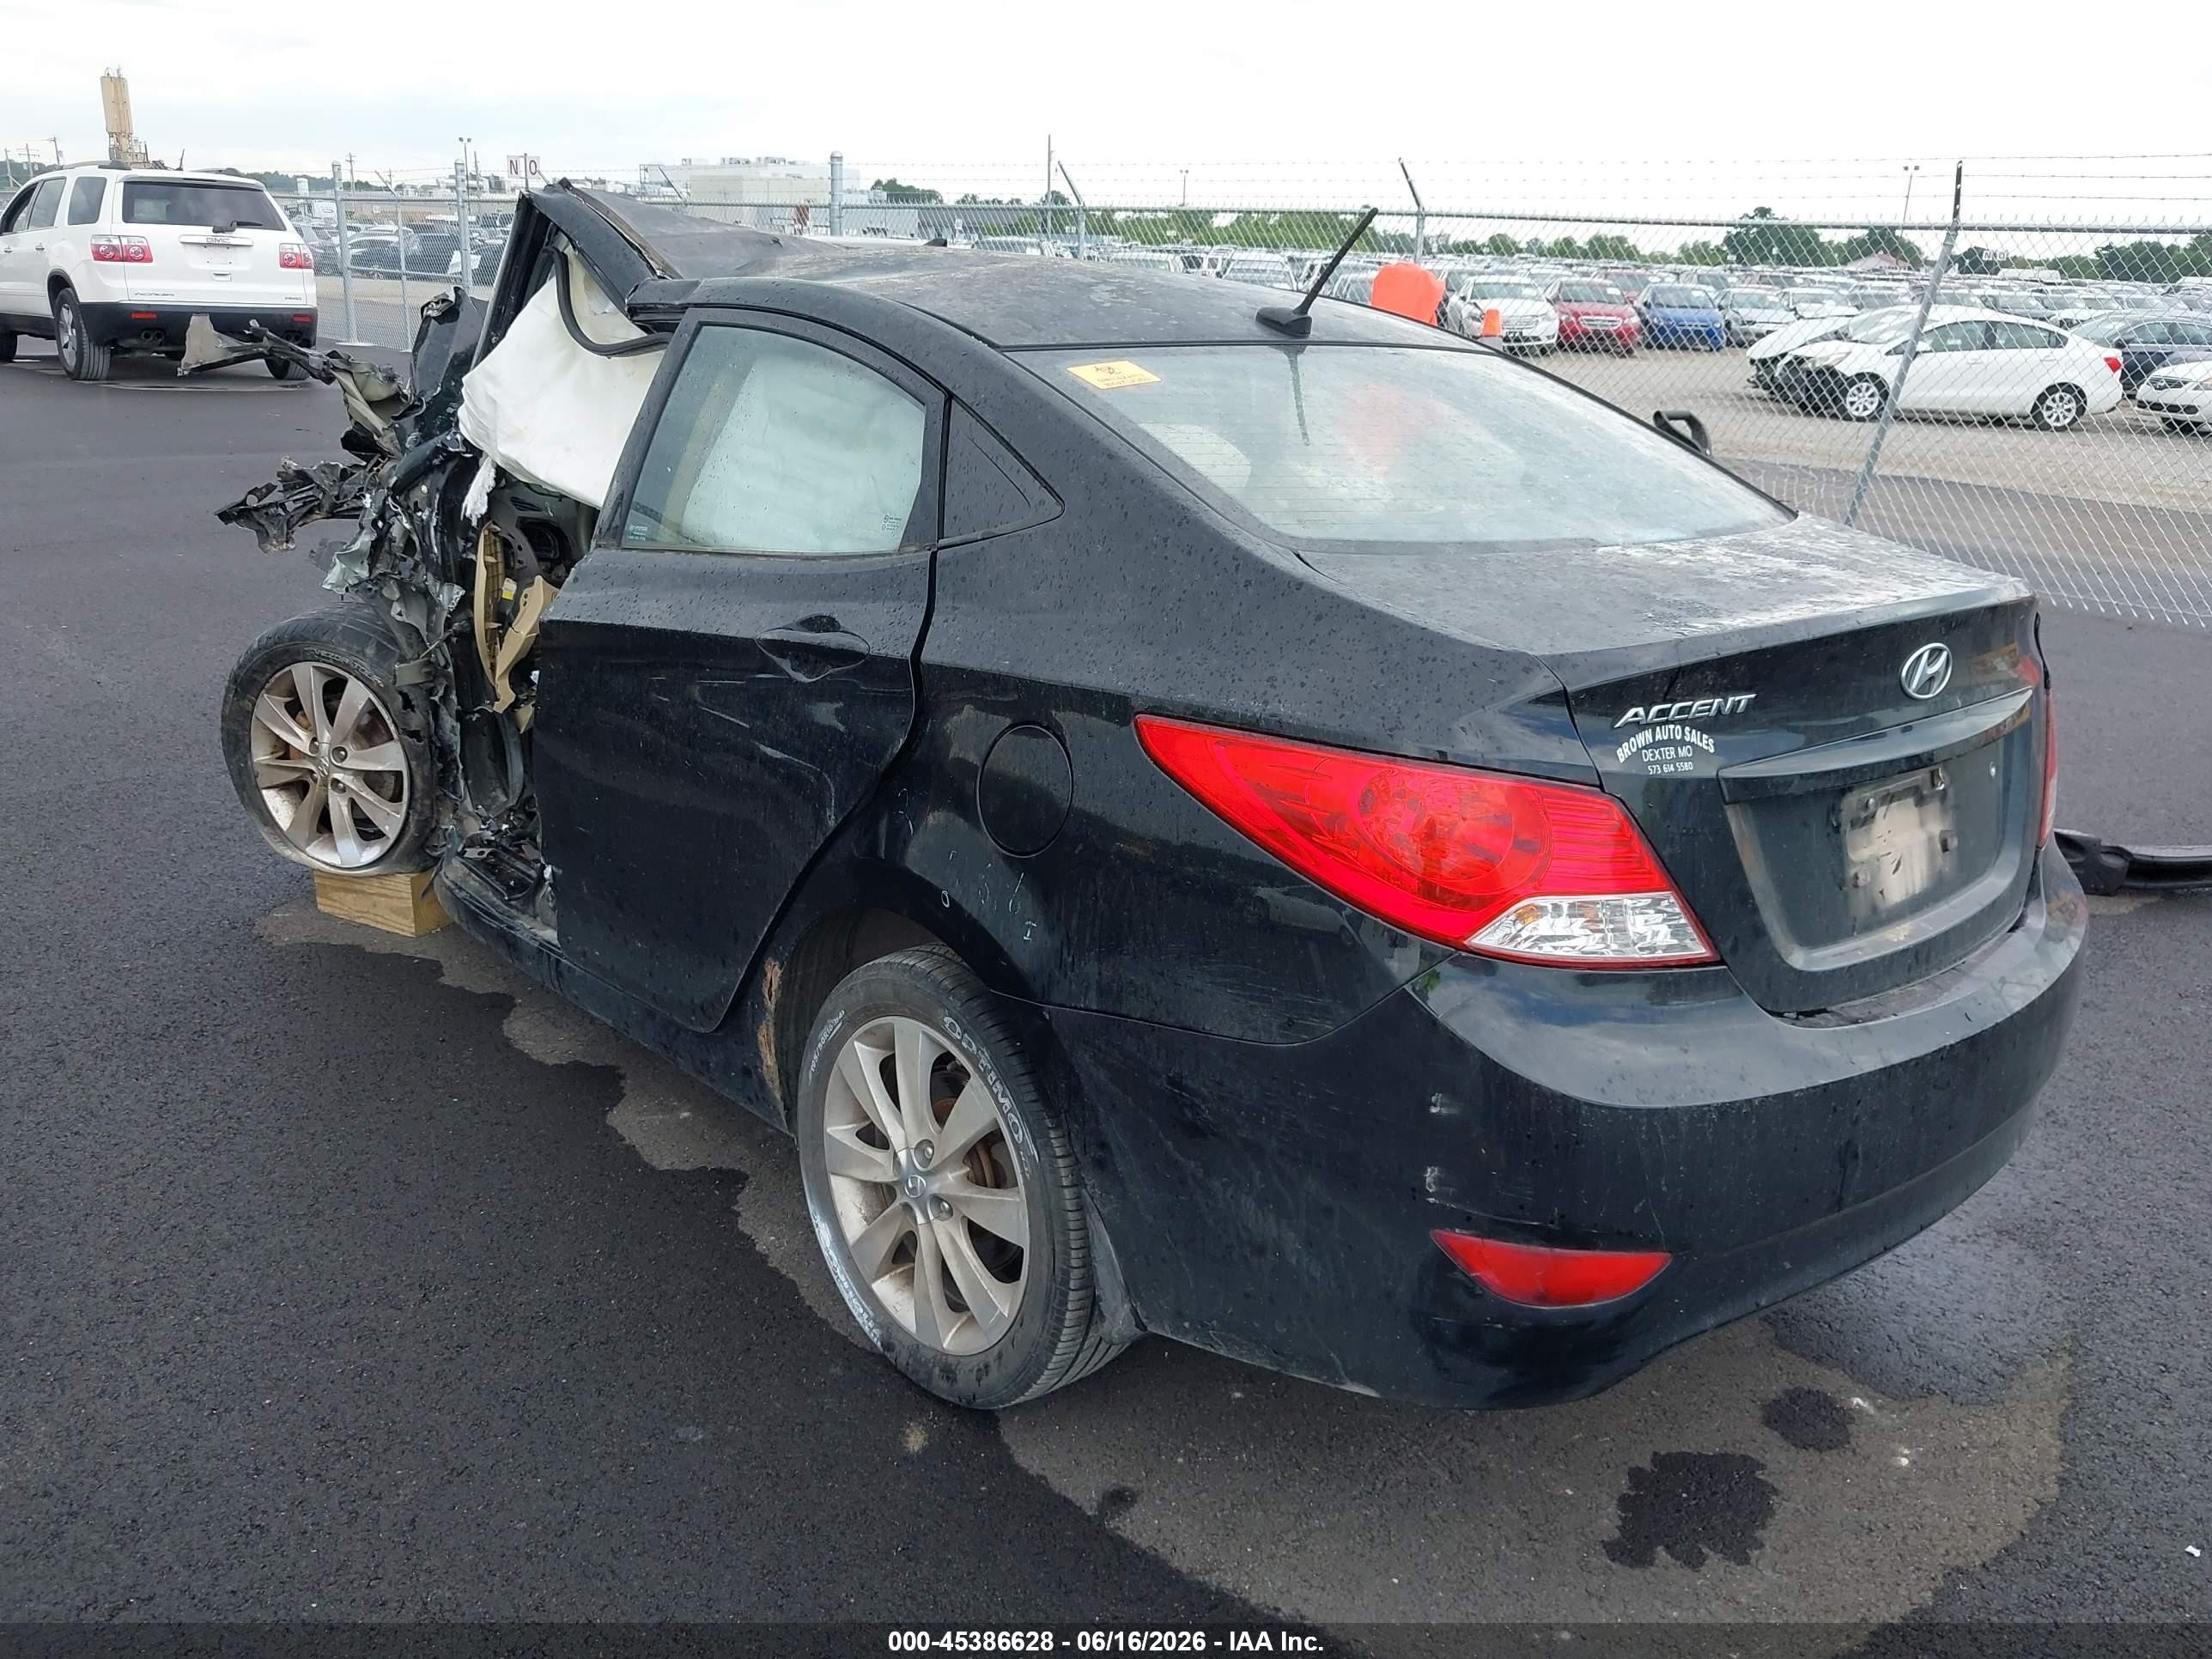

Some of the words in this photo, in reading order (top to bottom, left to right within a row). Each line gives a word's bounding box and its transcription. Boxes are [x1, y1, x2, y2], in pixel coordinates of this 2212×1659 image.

[1613, 693, 1758, 728] ACCENT
[1616, 728, 1653, 763] BROWN
[1655, 724, 1682, 742] AUTO
[1684, 726, 1716, 753] SALES
[1642, 746, 1676, 763] DEXTER
[1677, 744, 1693, 758] MO
[1648, 765, 1662, 775] 573
[1662, 763, 1675, 773] 614
[1676, 762, 1693, 772] 5580
[943, 1016, 1024, 1145] OPTIMO
